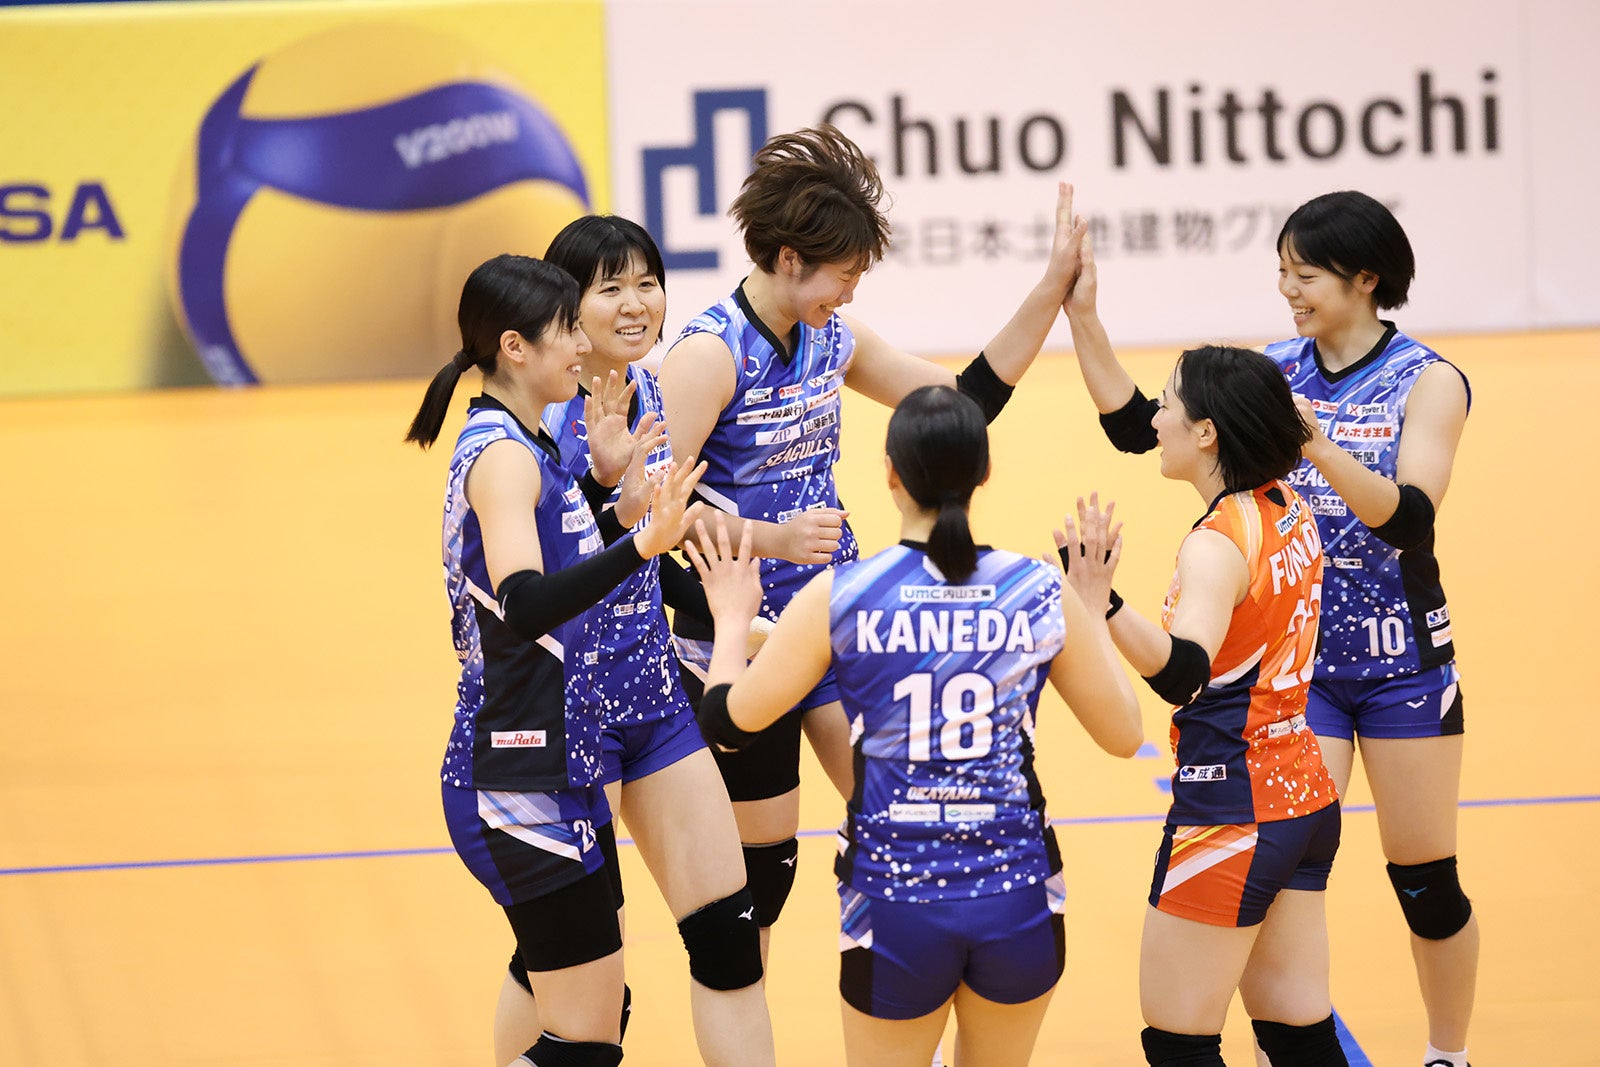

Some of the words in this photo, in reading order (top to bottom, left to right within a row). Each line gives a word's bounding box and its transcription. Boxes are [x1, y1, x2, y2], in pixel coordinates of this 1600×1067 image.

[822, 94, 1067, 177] Chuo
[1111, 70, 1500, 169] Nittochi
[0, 180, 126, 242] SA
[760, 437, 833, 469] SEAGULLS
[771, 429, 791, 443] ZIP
[856, 608, 1035, 653] KANEDA
[1361, 616, 1407, 657] 10
[660, 653, 673, 696] 5
[893, 672, 996, 761] 18
[494, 732, 542, 746] muRata
[1197, 767, 1225, 780] 成通
